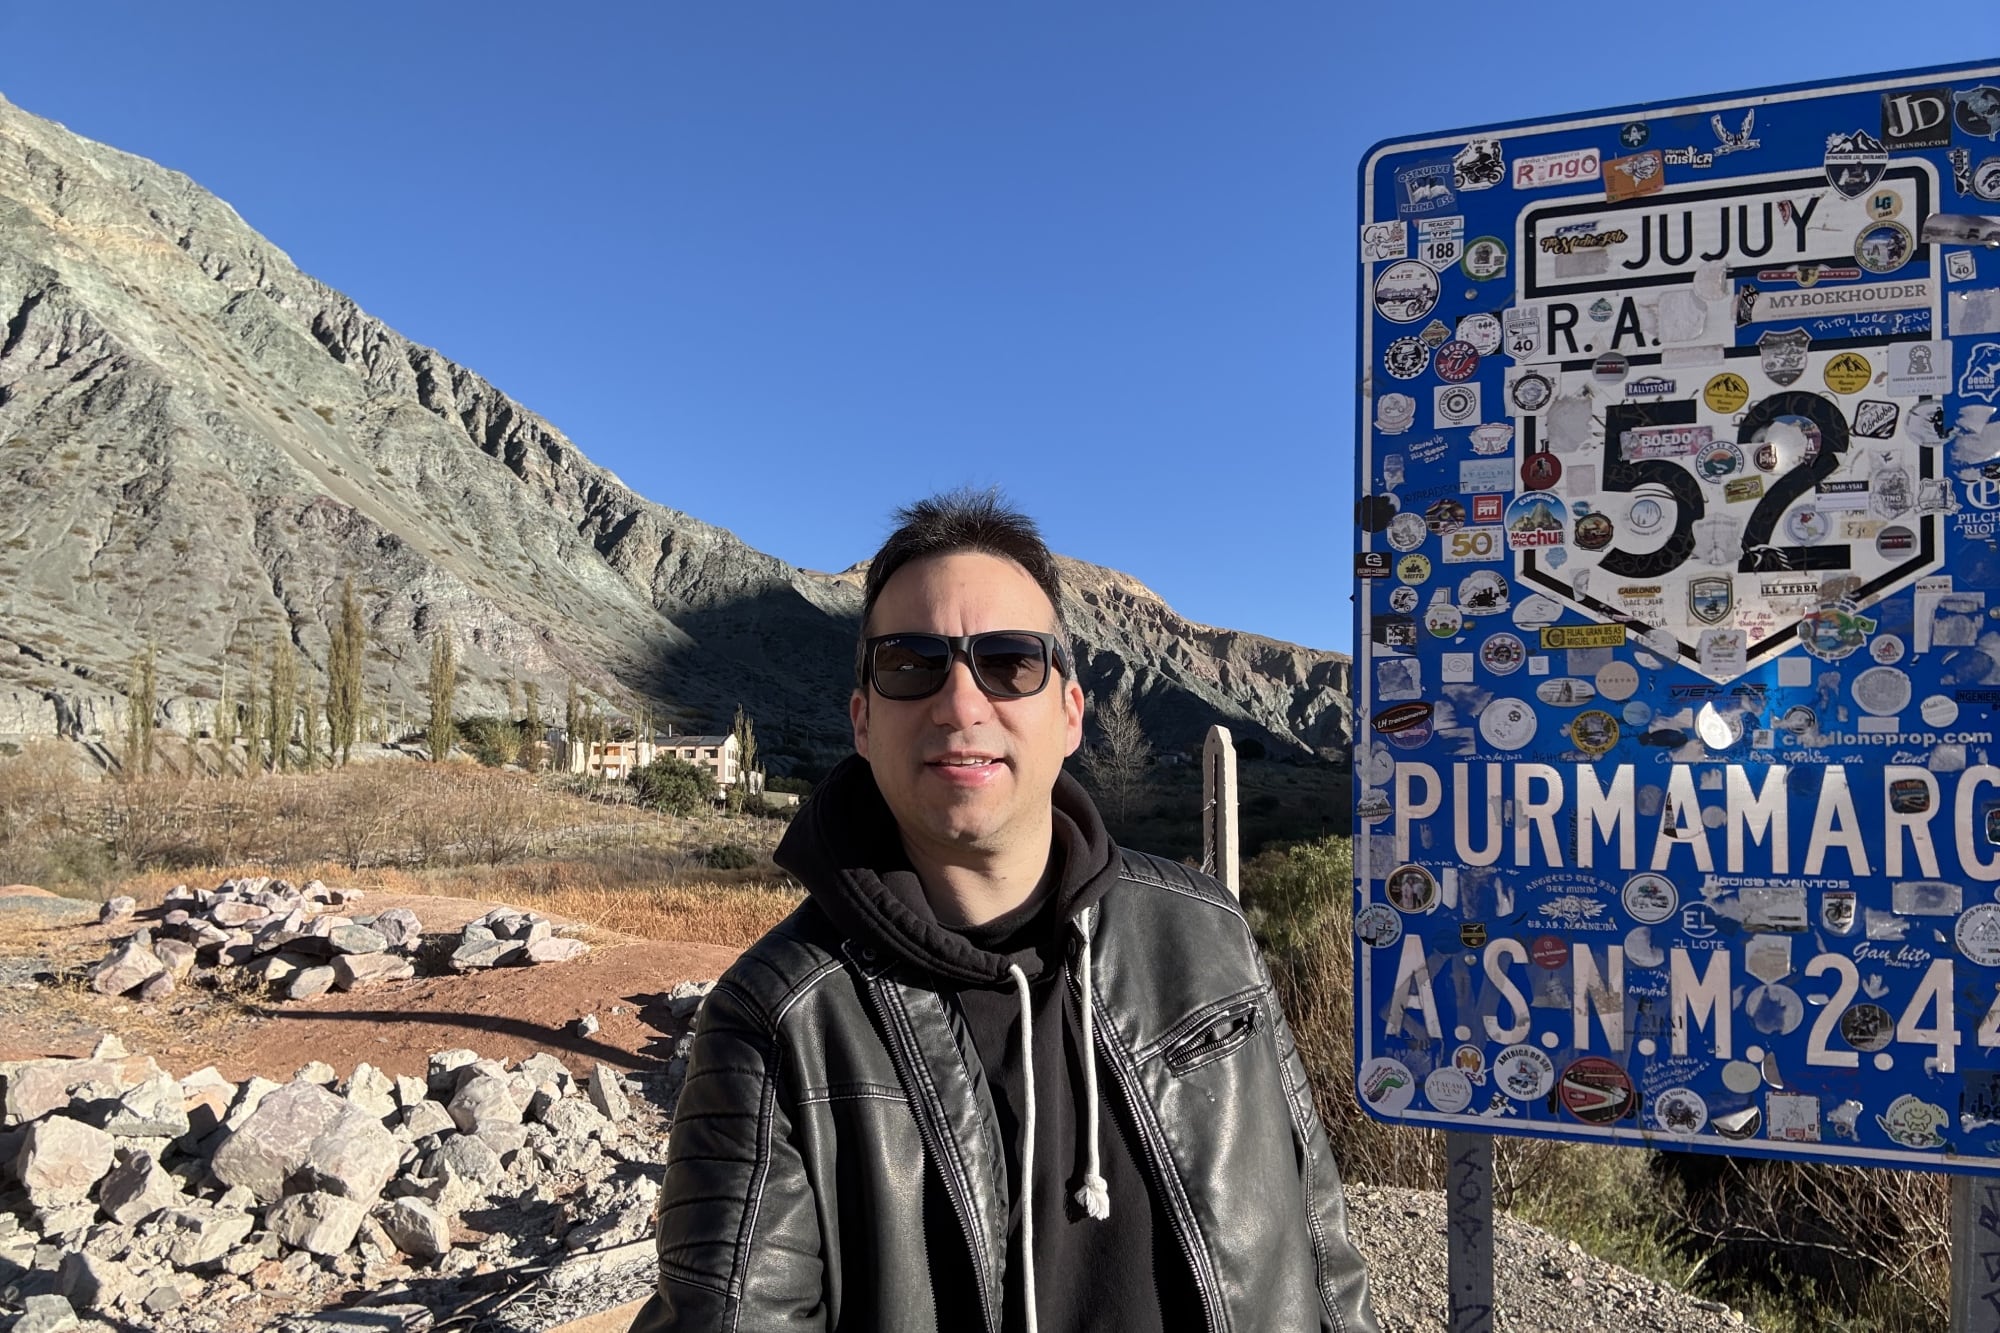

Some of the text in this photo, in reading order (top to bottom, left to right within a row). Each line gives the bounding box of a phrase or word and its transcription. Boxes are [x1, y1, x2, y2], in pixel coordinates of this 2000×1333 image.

[1888, 94, 1946, 137] JD
[1398, 164, 1451, 183] OSTKURVE
[1400, 201, 1435, 213] HERTHA
[1875, 195, 1892, 210] LG
[1621, 197, 1822, 270] JUJUY
[1426, 242, 1455, 260] 188
[1955, 266, 1970, 275] 40
[1769, 284, 1927, 309] MY BOEKHOUDER
[1512, 339, 1534, 353] 40
[1628, 381, 1674, 395] RALLYSTORY
[1861, 405, 1894, 435] Córdoba
[1641, 432, 1692, 447] BOEDO
[1597, 391, 1851, 578] 52
[1518, 492, 1556, 506] Expedición
[1451, 532, 1493, 557] 50
[1526, 529, 1558, 546] chu
[1566, 627, 1585, 637] FILIAL
[1585, 627, 1602, 636] GRAN
[1613, 626, 1622, 634] AS
[1567, 637, 1590, 646] MIGUEL
[1601, 635, 1622, 645] RUSSO
[1377, 719, 1388, 729] LH
[1683, 911, 1716, 929] EL
[1691, 939, 1726, 950] LOTE
[1530, 1050, 1541, 1061] DO
